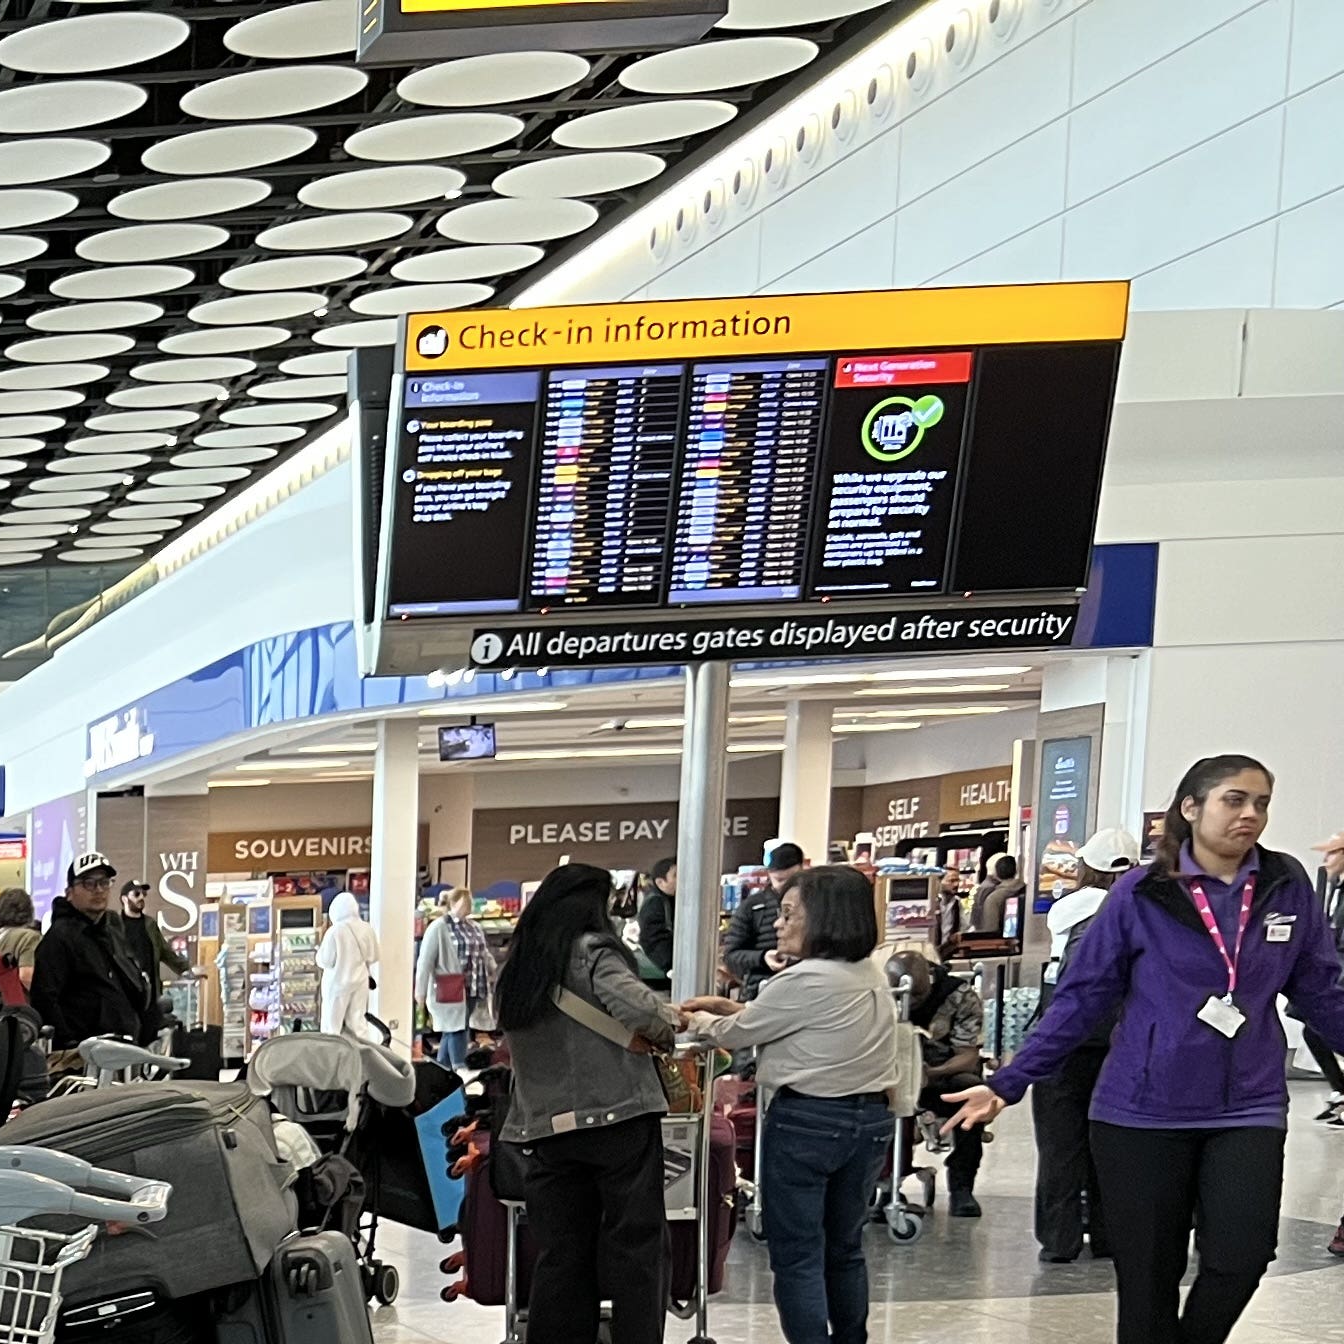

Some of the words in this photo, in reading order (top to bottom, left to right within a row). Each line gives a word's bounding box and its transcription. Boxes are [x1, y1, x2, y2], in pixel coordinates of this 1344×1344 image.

[459, 319, 593, 350] Check-in
[604, 310, 791, 344] information
[506, 631, 541, 656] All
[546, 631, 686, 660] departures
[692, 628, 764, 654] gates
[769, 617, 897, 650] displayed
[900, 615, 964, 640] after
[967, 611, 1072, 640] security
[887, 797, 920, 821] SELF
[510, 821, 611, 844] PLEASE
[619, 819, 670, 841] PAY
[875, 821, 929, 848] SERVICE
[159, 852, 198, 871] WH
[157, 871, 198, 932] S
